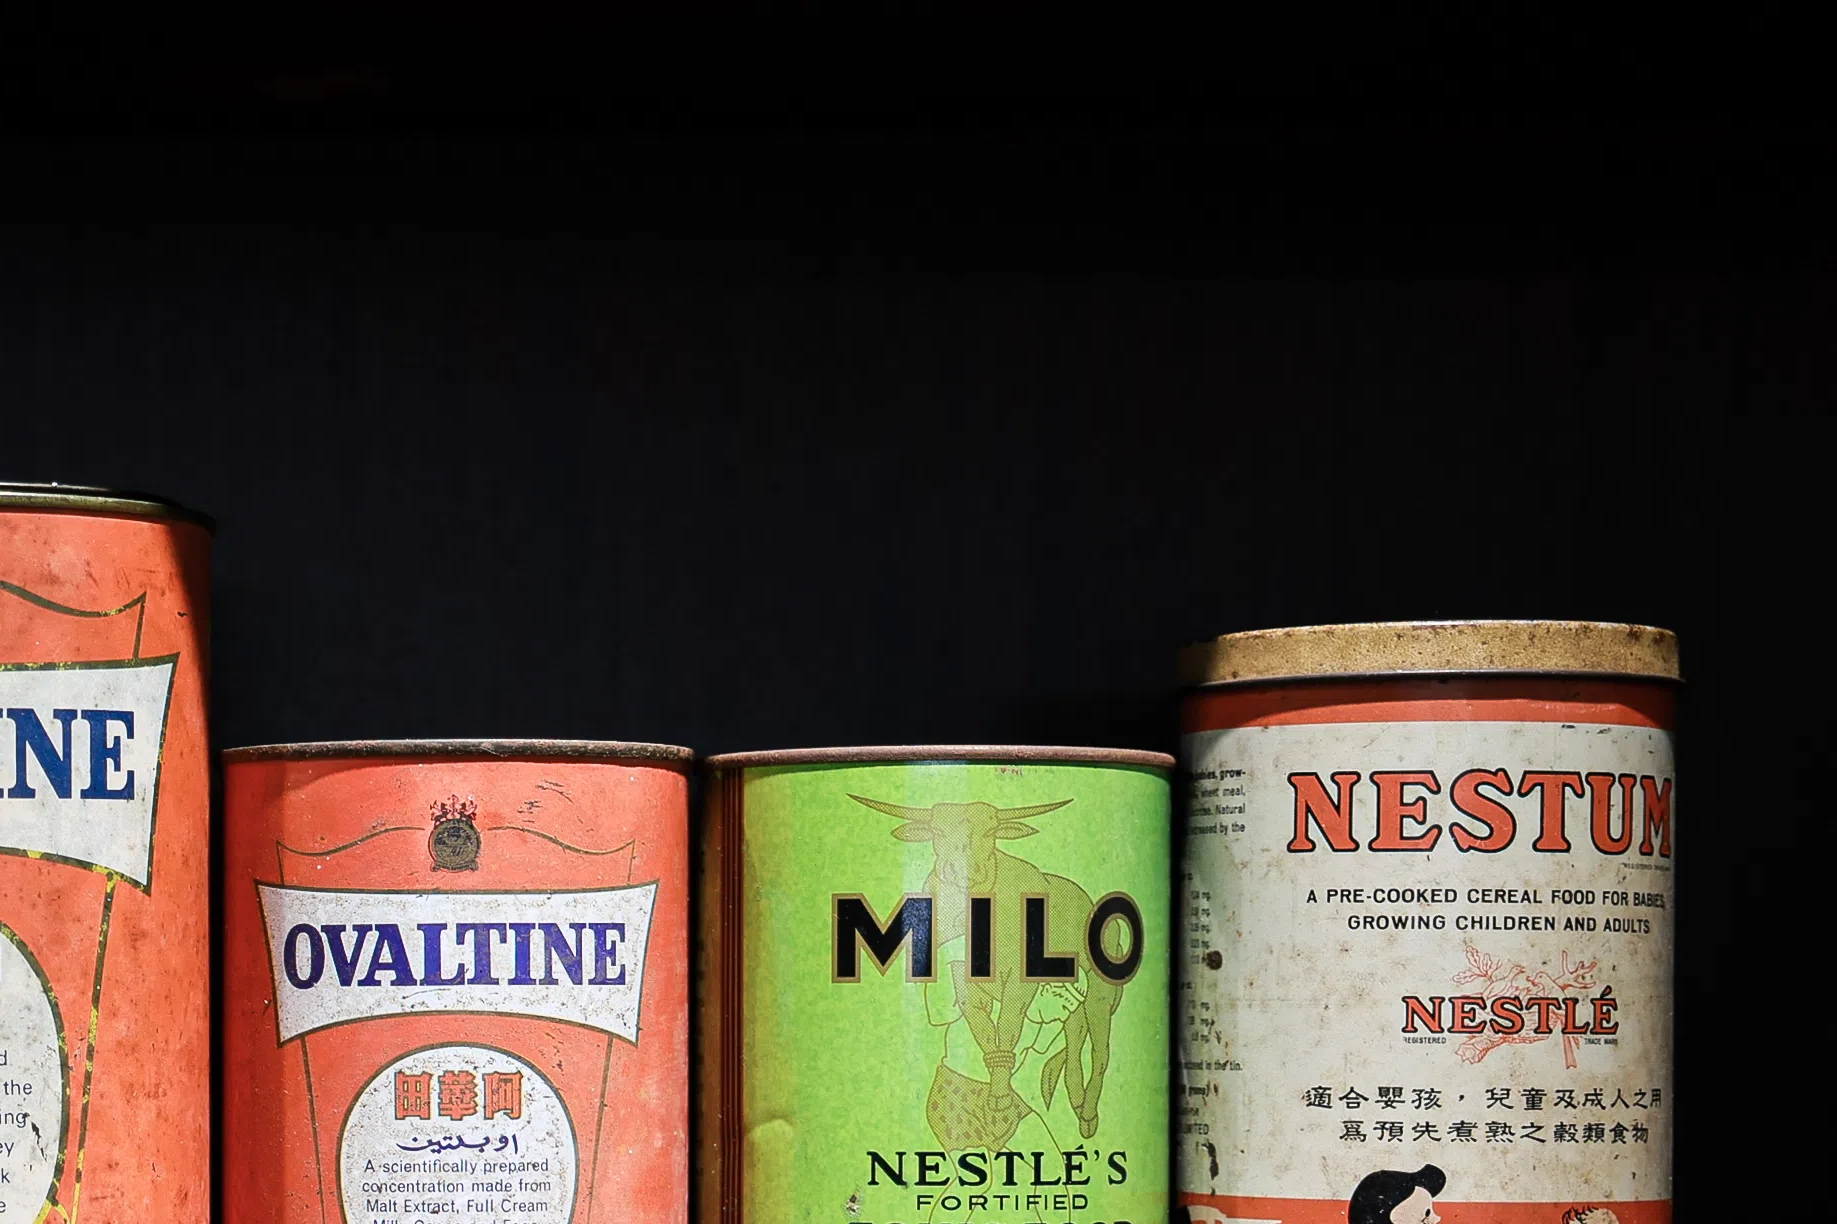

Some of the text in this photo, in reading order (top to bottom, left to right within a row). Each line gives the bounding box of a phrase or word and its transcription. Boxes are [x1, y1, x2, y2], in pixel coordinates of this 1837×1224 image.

[1285, 767, 1673, 859] NESTUM
[1306, 890, 1318, 904] A
[1326, 888, 1458, 904] PRE-COOKED
[1466, 887, 1543, 905] CEREAL
[1550, 889, 1596, 905] FOOD
[1602, 890, 1629, 907] FOR
[1347, 914, 1651, 935] GROWING CHILDREN AND ADULTS
[831, 890, 1145, 984] MILO
[282, 922, 628, 990] OVALTINE
[1400, 985, 1620, 1035] NESTLÉ
[3, 1079, 33, 1097] the
[364, 1159, 549, 1175] A scientifically prepared
[362, 1178, 551, 1194] concentration made from
[366, 1199, 549, 1215] Malt Extract, Full Cream
[915, 1193, 1090, 1211] FORTIFIED
